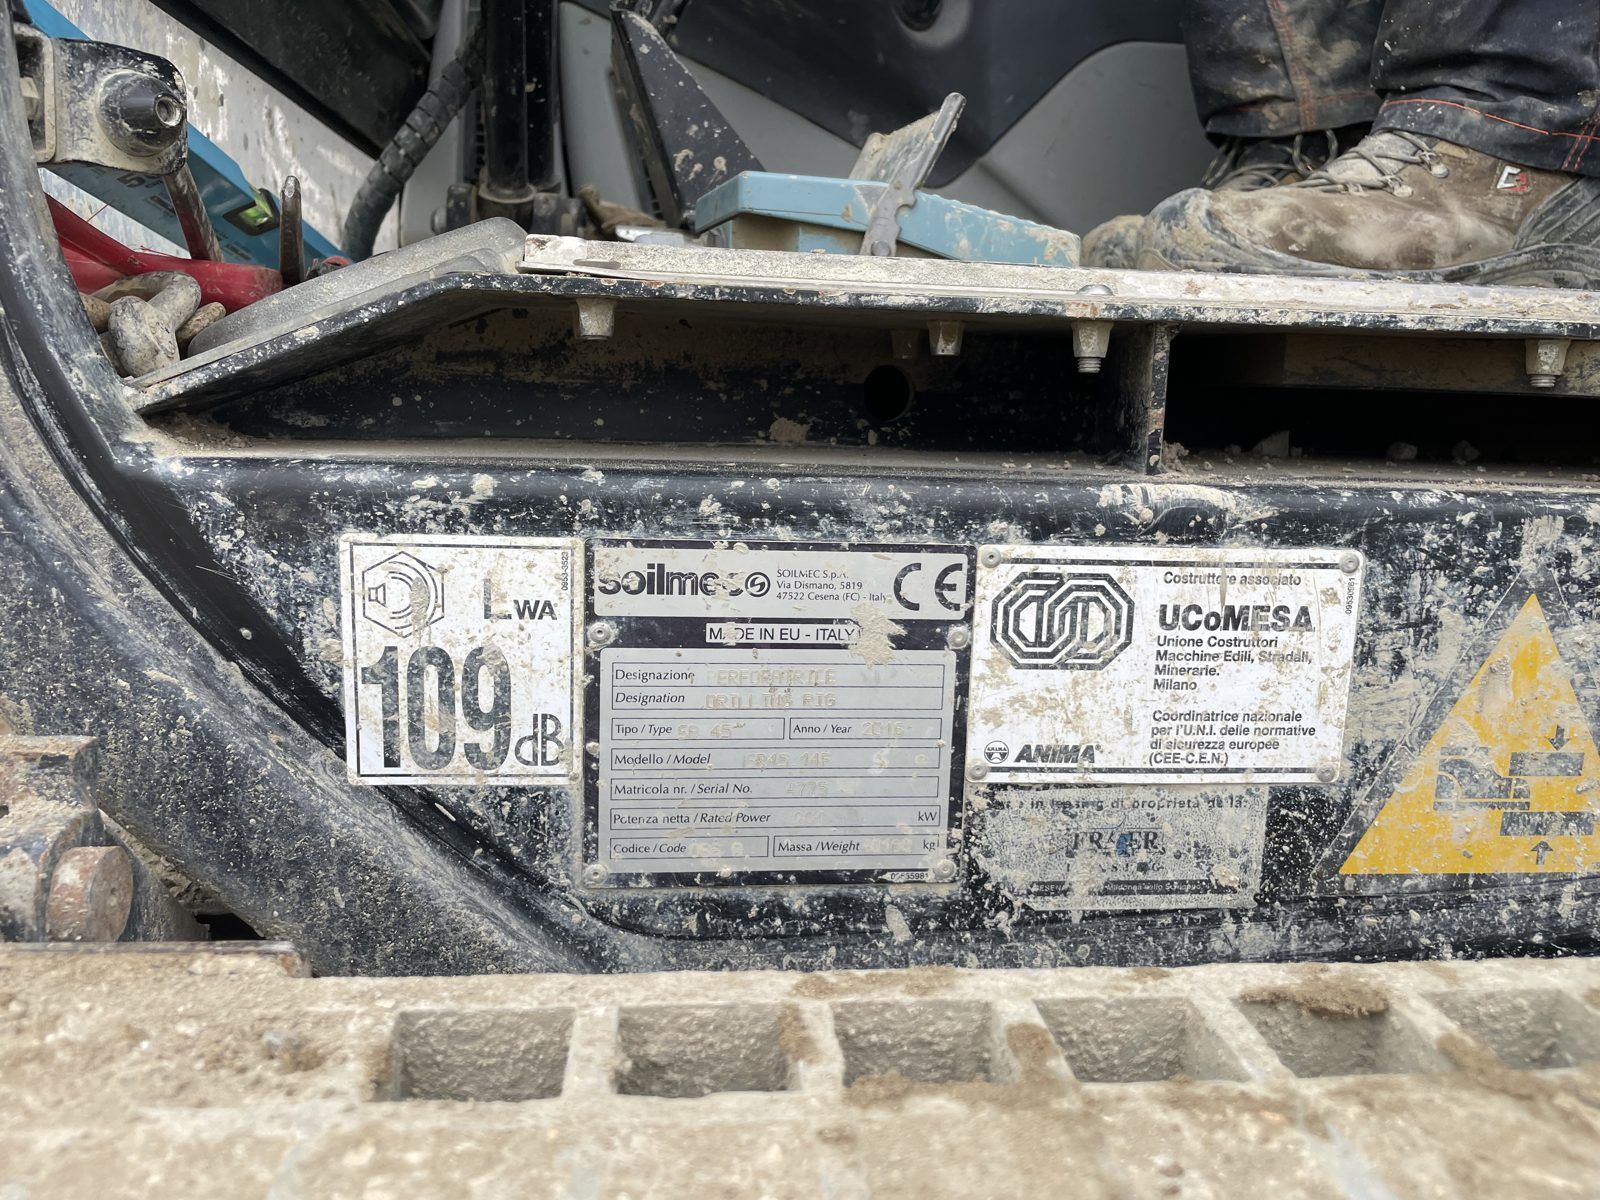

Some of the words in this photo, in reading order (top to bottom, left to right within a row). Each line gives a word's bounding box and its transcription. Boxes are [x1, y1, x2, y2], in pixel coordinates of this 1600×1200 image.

[776, 569, 821, 579] SOILMEC
[776, 580, 791, 589] Via
[794, 580, 837, 590] Dismano,
[840, 581, 863, 590] 5819
[776, 592, 805, 600] 47522
[807, 592, 840, 601] Cesena
[842, 592, 860, 602] (FC)
[869, 592, 887, 603] Italy
[1158, 603, 1314, 632] UCoMESA
[709, 627, 755, 640] MDE
[759, 627, 775, 640] IN
[779, 628, 800, 640] EU
[815, 628, 856, 641] ITALY
[1157, 635, 1204, 647] Unione
[1207, 635, 1278, 648] Costruttori
[1155, 650, 1220, 662] Macchine
[1223, 650, 1255, 664] Edili,
[615, 669, 695, 683] Designazione
[1154, 664, 1220, 677] Minerarie.
[1153, 678, 1198, 690] Milano
[615, 692, 685, 706] Designation
[360, 645, 512, 771] 109
[1152, 710, 1239, 722] Coordinatrice
[1242, 710, 1303, 722] nazionale
[615, 724, 638, 736] Tipo
[648, 724, 672, 736] Type
[793, 724, 821, 733] Anno
[831, 724, 852, 733] Year
[1151, 725, 1172, 738] per
[1219, 725, 1250, 736] delle
[1253, 725, 1316, 736] normative
[514, 713, 565, 767] dB
[1150, 739, 1162, 750] di
[1165, 739, 1226, 750] sicurezza
[1228, 740, 1280, 753] europee
[614, 753, 664, 764] Modello
[672, 753, 711, 764] Model
[1013, 744, 1095, 764] ANIMA
[614, 783, 669, 794] Matricola
[673, 786, 687, 794] nr.
[696, 783, 729, 794] Serial
[732, 783, 753, 794] No.
[613, 814, 658, 824] Potenza
[662, 814, 690, 824] netta
[700, 812, 733, 823] Rated
[735, 812, 771, 823] Power
[918, 811, 938, 821] kW
[613, 843, 650, 853] Codice
[659, 842, 687, 853] Code
[777, 842, 812, 851] Massa
[820, 840, 860, 854] Weight
[922, 839, 936, 851] kg
